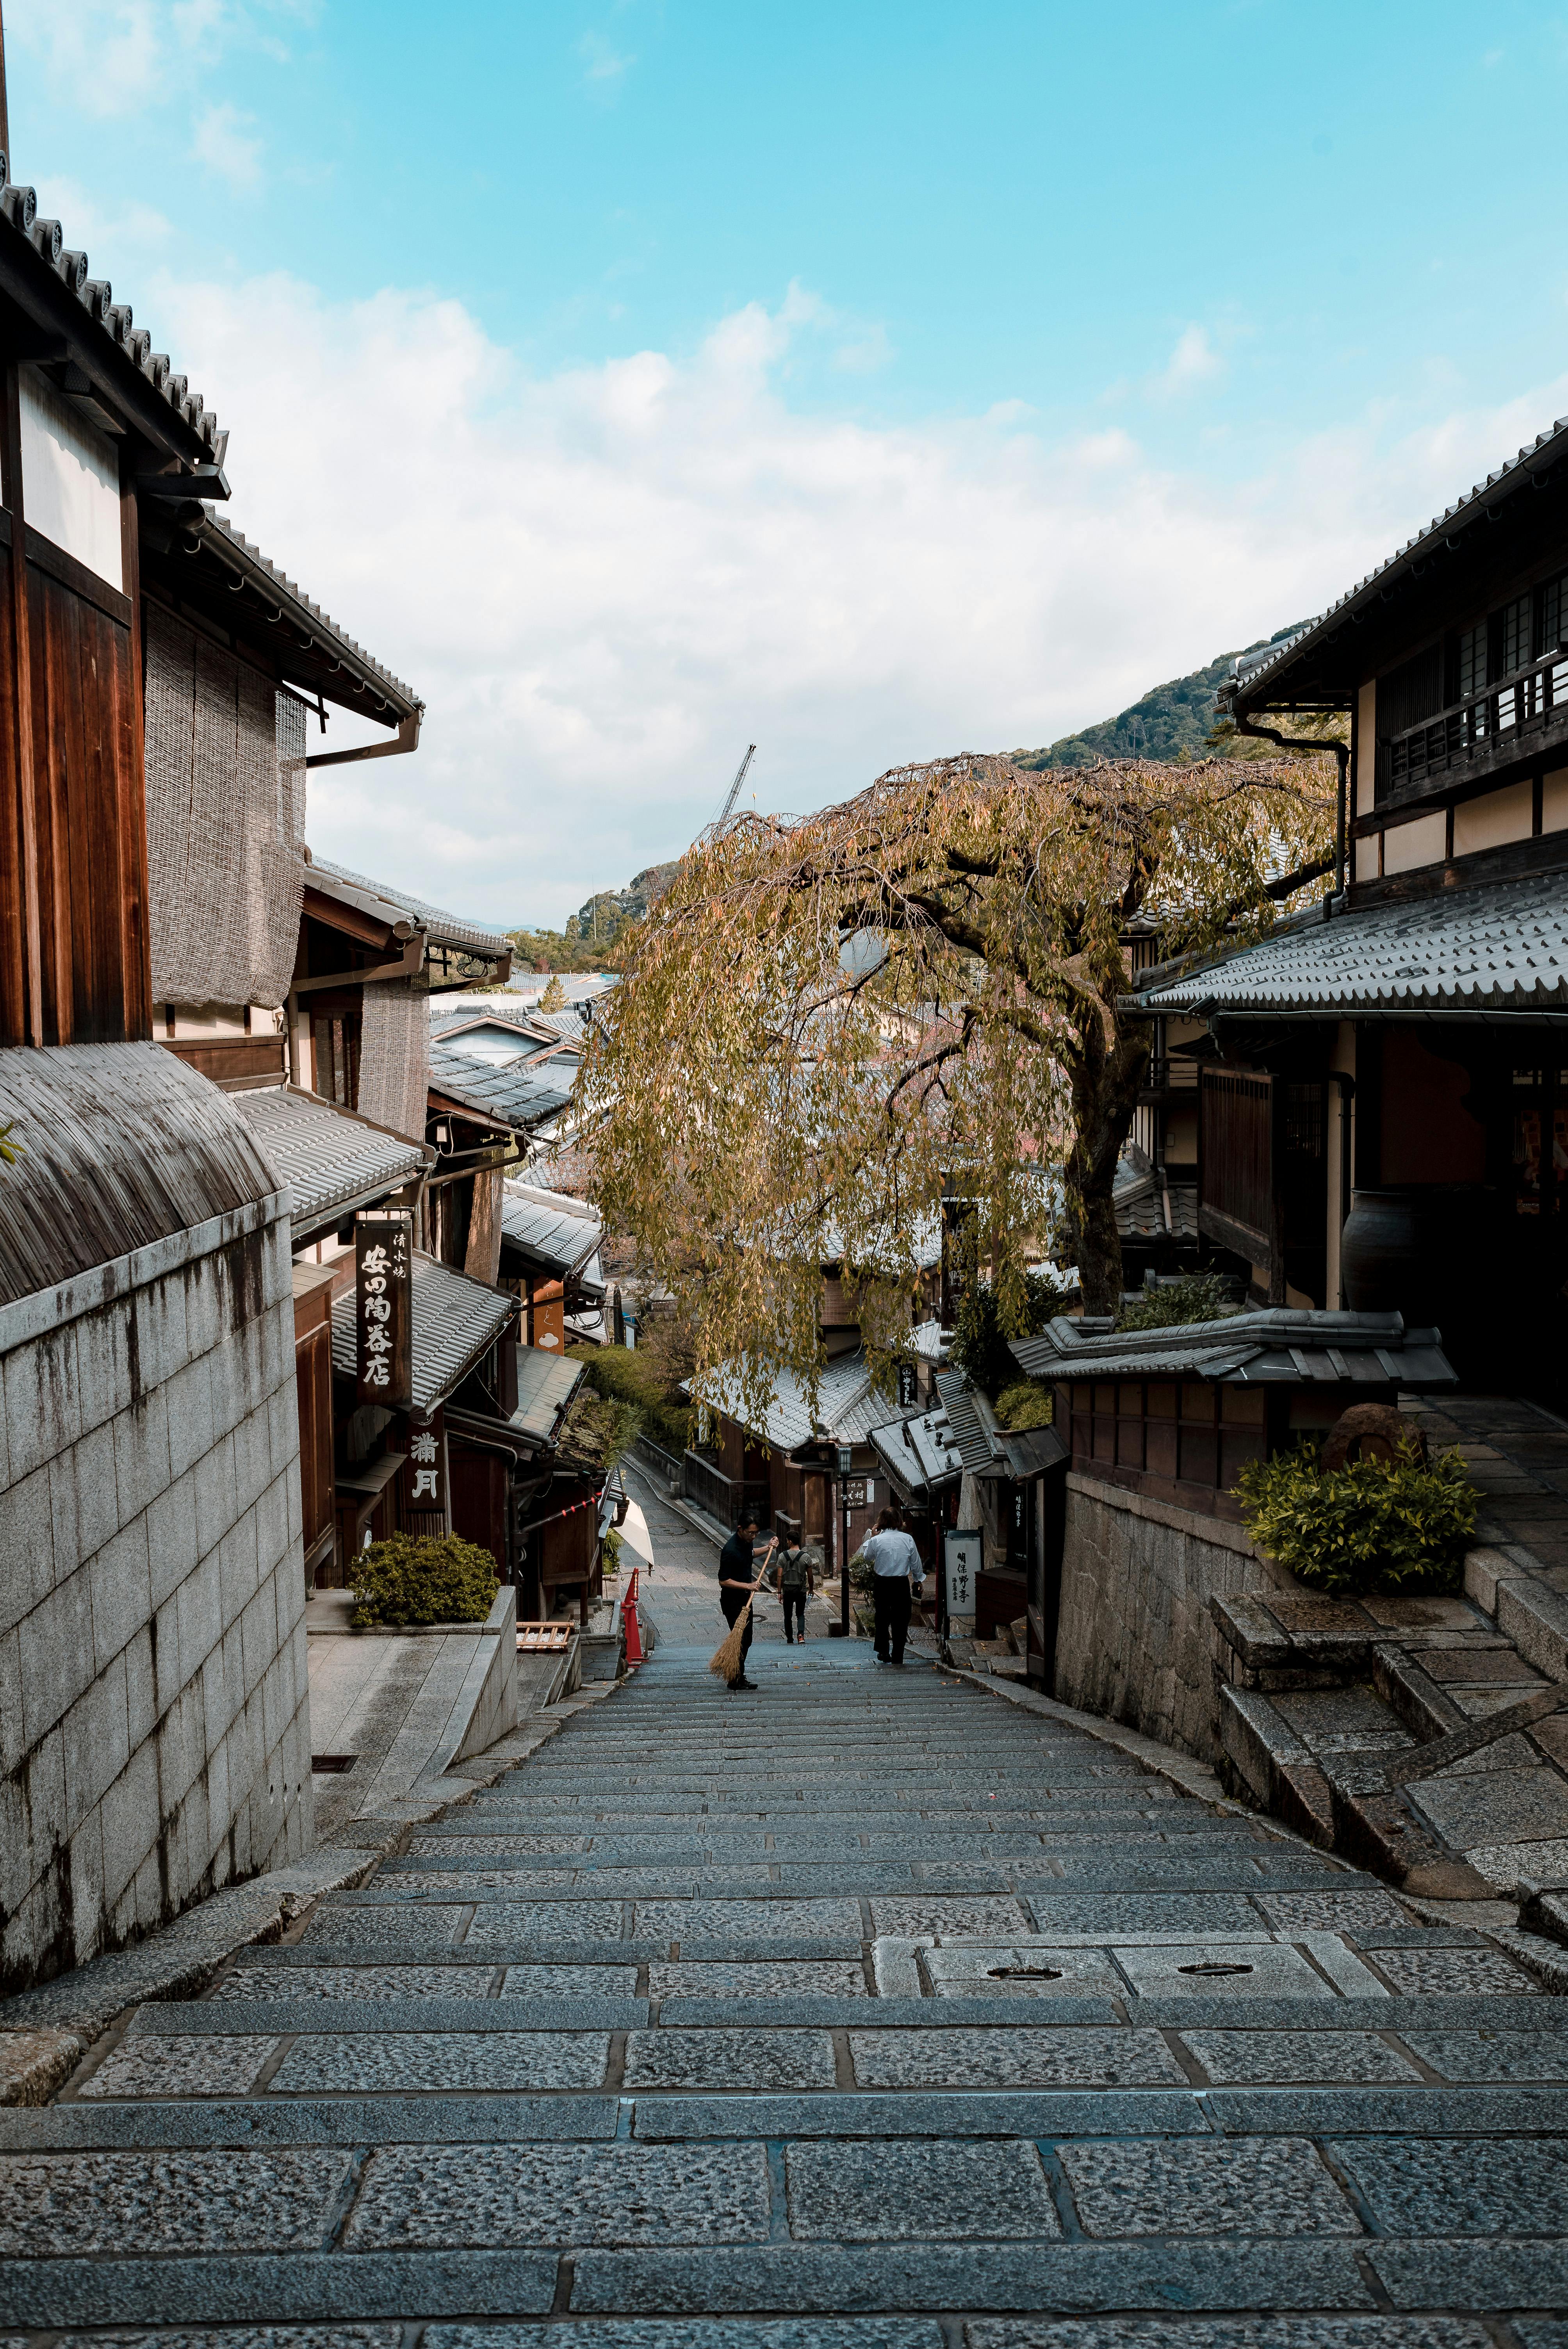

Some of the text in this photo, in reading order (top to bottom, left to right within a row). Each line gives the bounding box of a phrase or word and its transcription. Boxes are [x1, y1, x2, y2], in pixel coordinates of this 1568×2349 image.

[393, 1233, 408, 1278] 清水焼
[362, 1244, 393, 1385] 安田陶器店
[957, 1552, 969, 1603] 明保野亭
